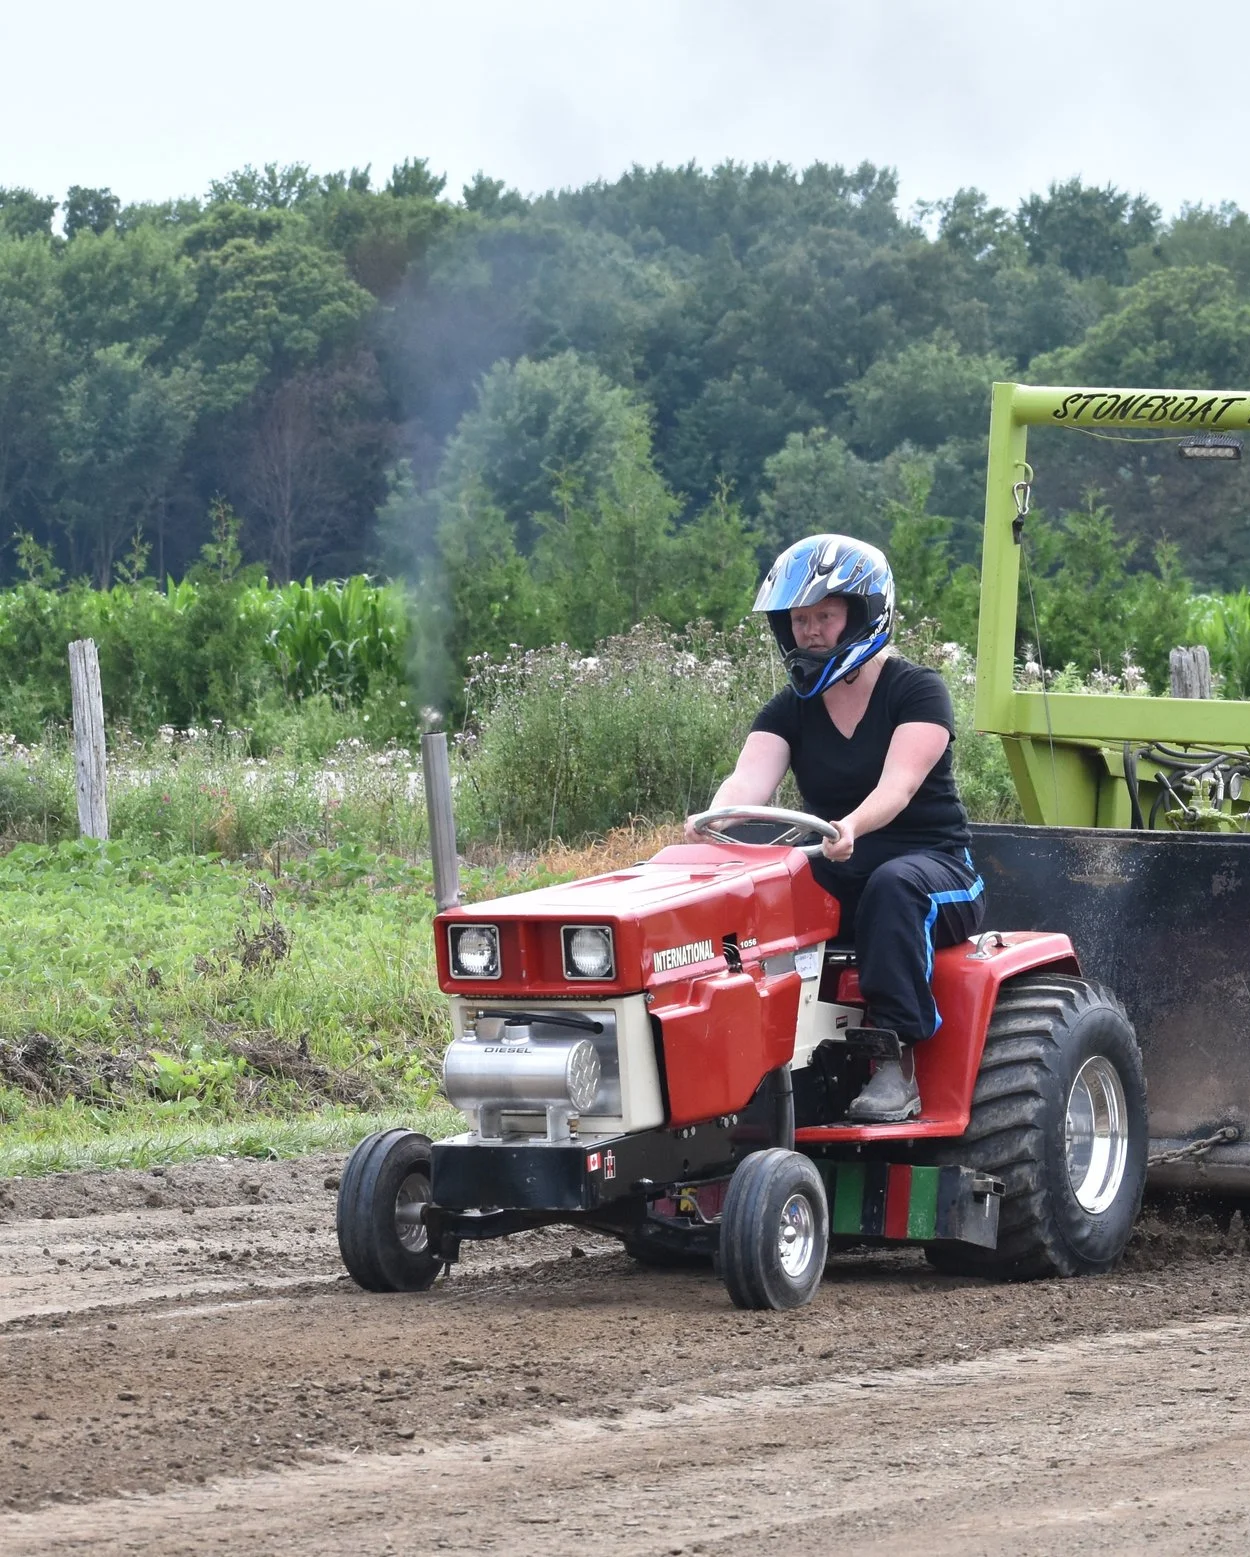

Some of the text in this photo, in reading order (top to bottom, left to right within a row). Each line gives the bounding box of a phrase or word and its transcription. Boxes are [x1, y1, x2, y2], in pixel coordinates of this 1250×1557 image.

[1053, 393, 1247, 424] STONEBOAT
[653, 938, 757, 973] INTERNATIONAL 1056
